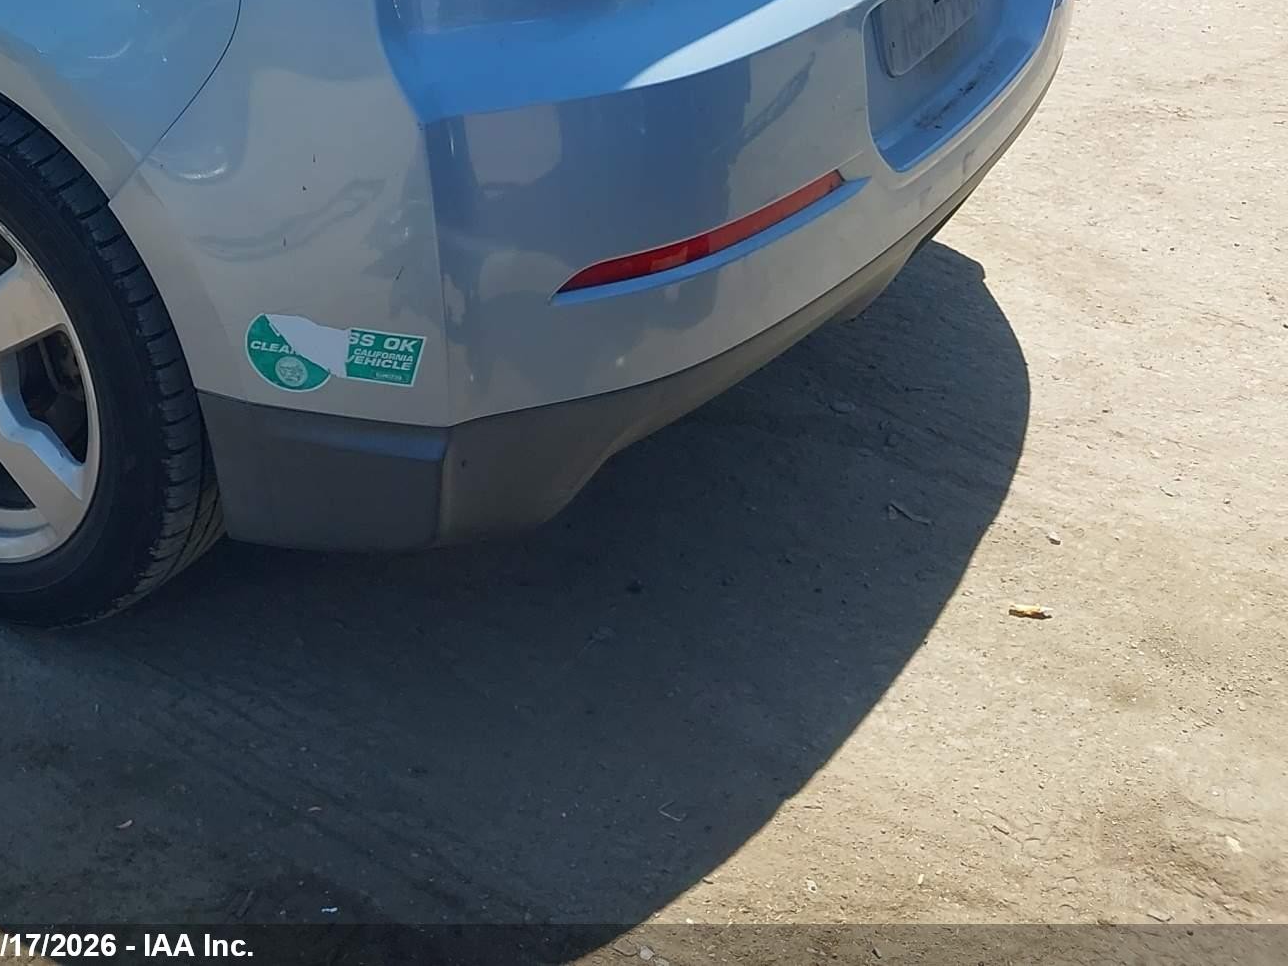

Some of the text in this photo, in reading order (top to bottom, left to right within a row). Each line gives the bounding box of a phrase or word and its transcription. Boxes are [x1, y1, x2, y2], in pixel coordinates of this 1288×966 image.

[250, 340, 296, 354] CLEA
[383, 337, 418, 352] OK
[353, 348, 414, 362] CALIFORNIA
